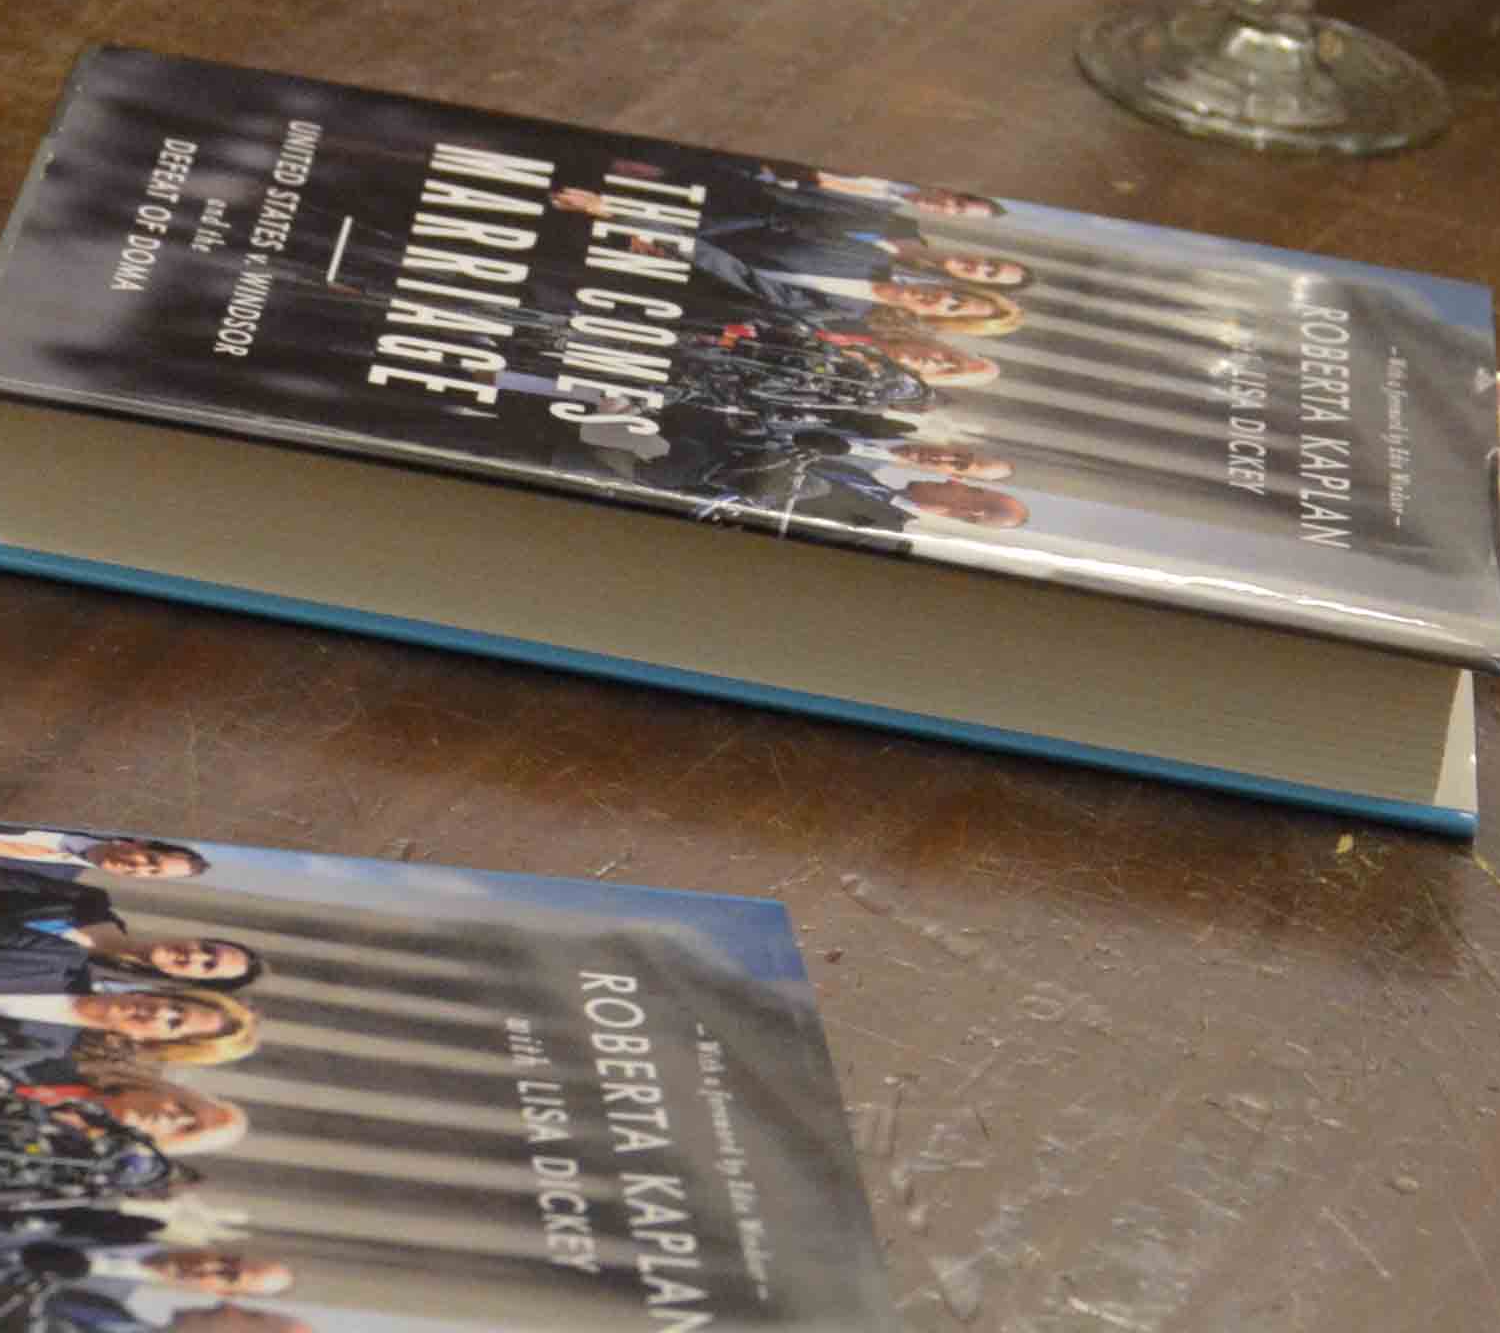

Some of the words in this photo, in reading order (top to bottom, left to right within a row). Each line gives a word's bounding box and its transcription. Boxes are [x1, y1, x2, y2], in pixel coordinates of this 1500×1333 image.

[150, 137, 199, 206] DEFEAT
[278, 118, 323, 184] UNITED
[139, 204, 171, 237] OF
[189, 224, 225, 253] the
[199, 197, 226, 225] and
[253, 185, 301, 253] STATES
[583, 171, 707, 285] THEN
[110, 238, 163, 293] DOMA
[367, 142, 556, 407] MARRIAGE
[212, 268, 274, 359] WINDSOR
[548, 287, 685, 441] COMES
[1229, 370, 1267, 409] LISA
[1299, 304, 1350, 423] ROBERTA
[1227, 417, 1267, 496] DICKEY
[1299, 434, 1352, 550] KAPLAN
[504, 1016, 552, 1070] with
[579, 969, 674, 1154] ROBERTA
[514, 1077, 573, 1149] LISA
[531, 1154, 600, 1275] DICKEY
[619, 1171, 716, 1333] KAPLAN
